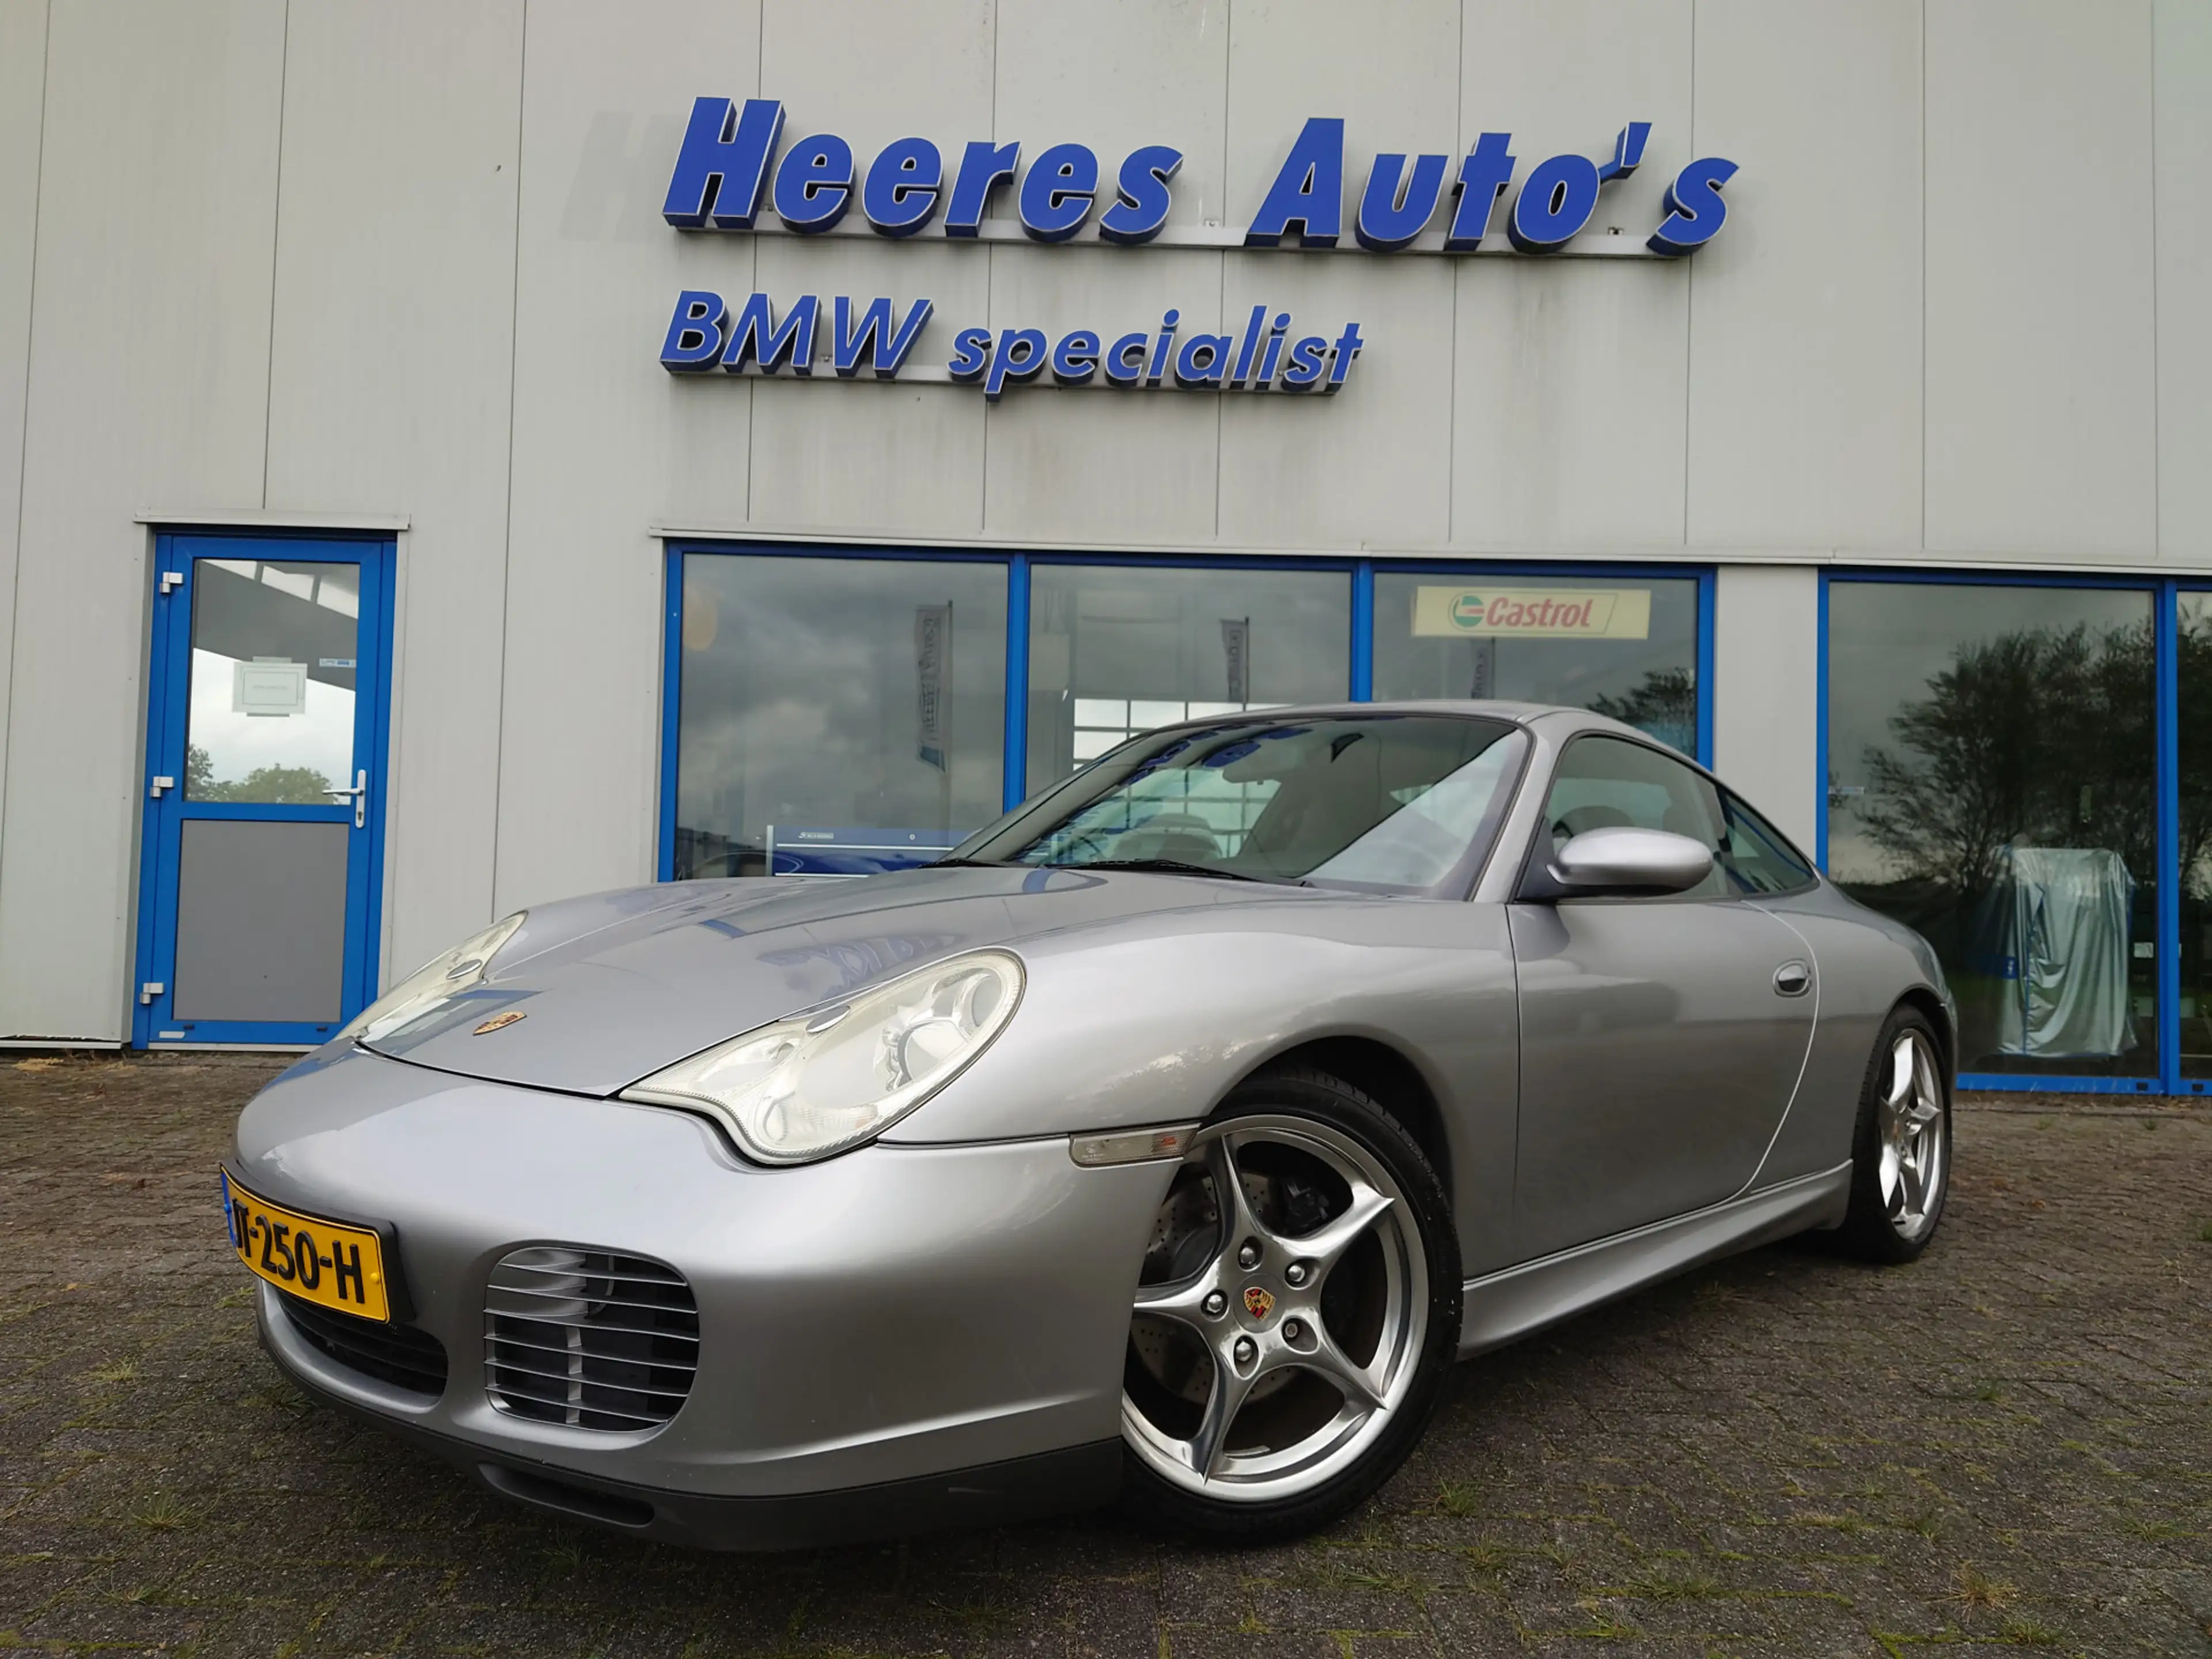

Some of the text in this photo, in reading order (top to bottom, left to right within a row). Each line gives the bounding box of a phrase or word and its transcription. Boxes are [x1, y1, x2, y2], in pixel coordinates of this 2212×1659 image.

[662, 96, 1740, 256] Heeres Auto's
[659, 290, 1364, 403] BMW specialist
[1486, 597, 1593, 628] Castrol
